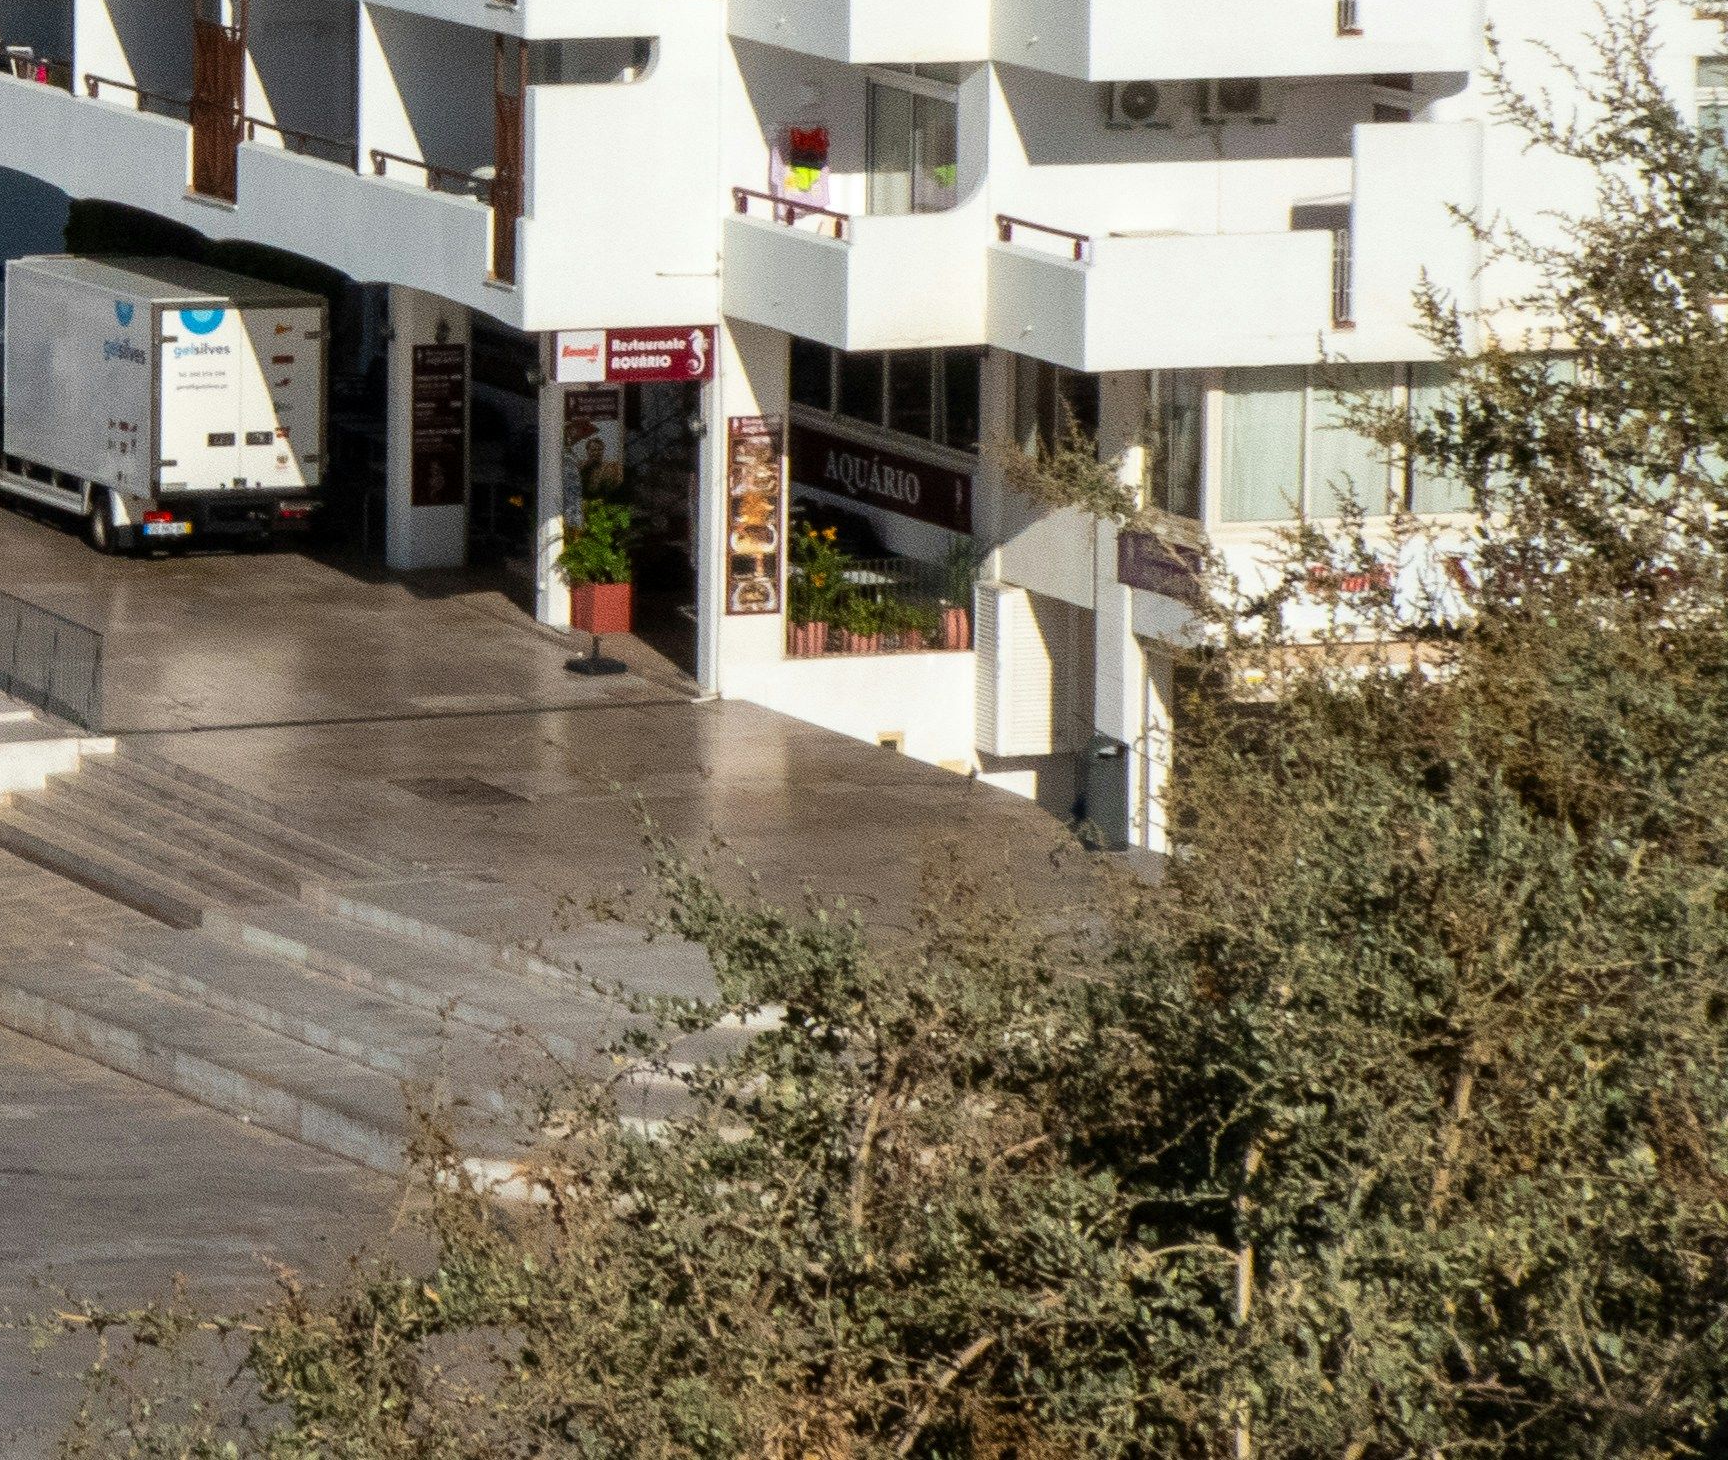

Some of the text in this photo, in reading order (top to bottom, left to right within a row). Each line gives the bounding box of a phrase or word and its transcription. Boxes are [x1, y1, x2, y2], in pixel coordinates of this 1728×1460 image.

[173, 343, 231, 359] gelsilves
[611, 338, 686, 353] Restaurante
[823, 449, 921, 505] AQUÁRIO
